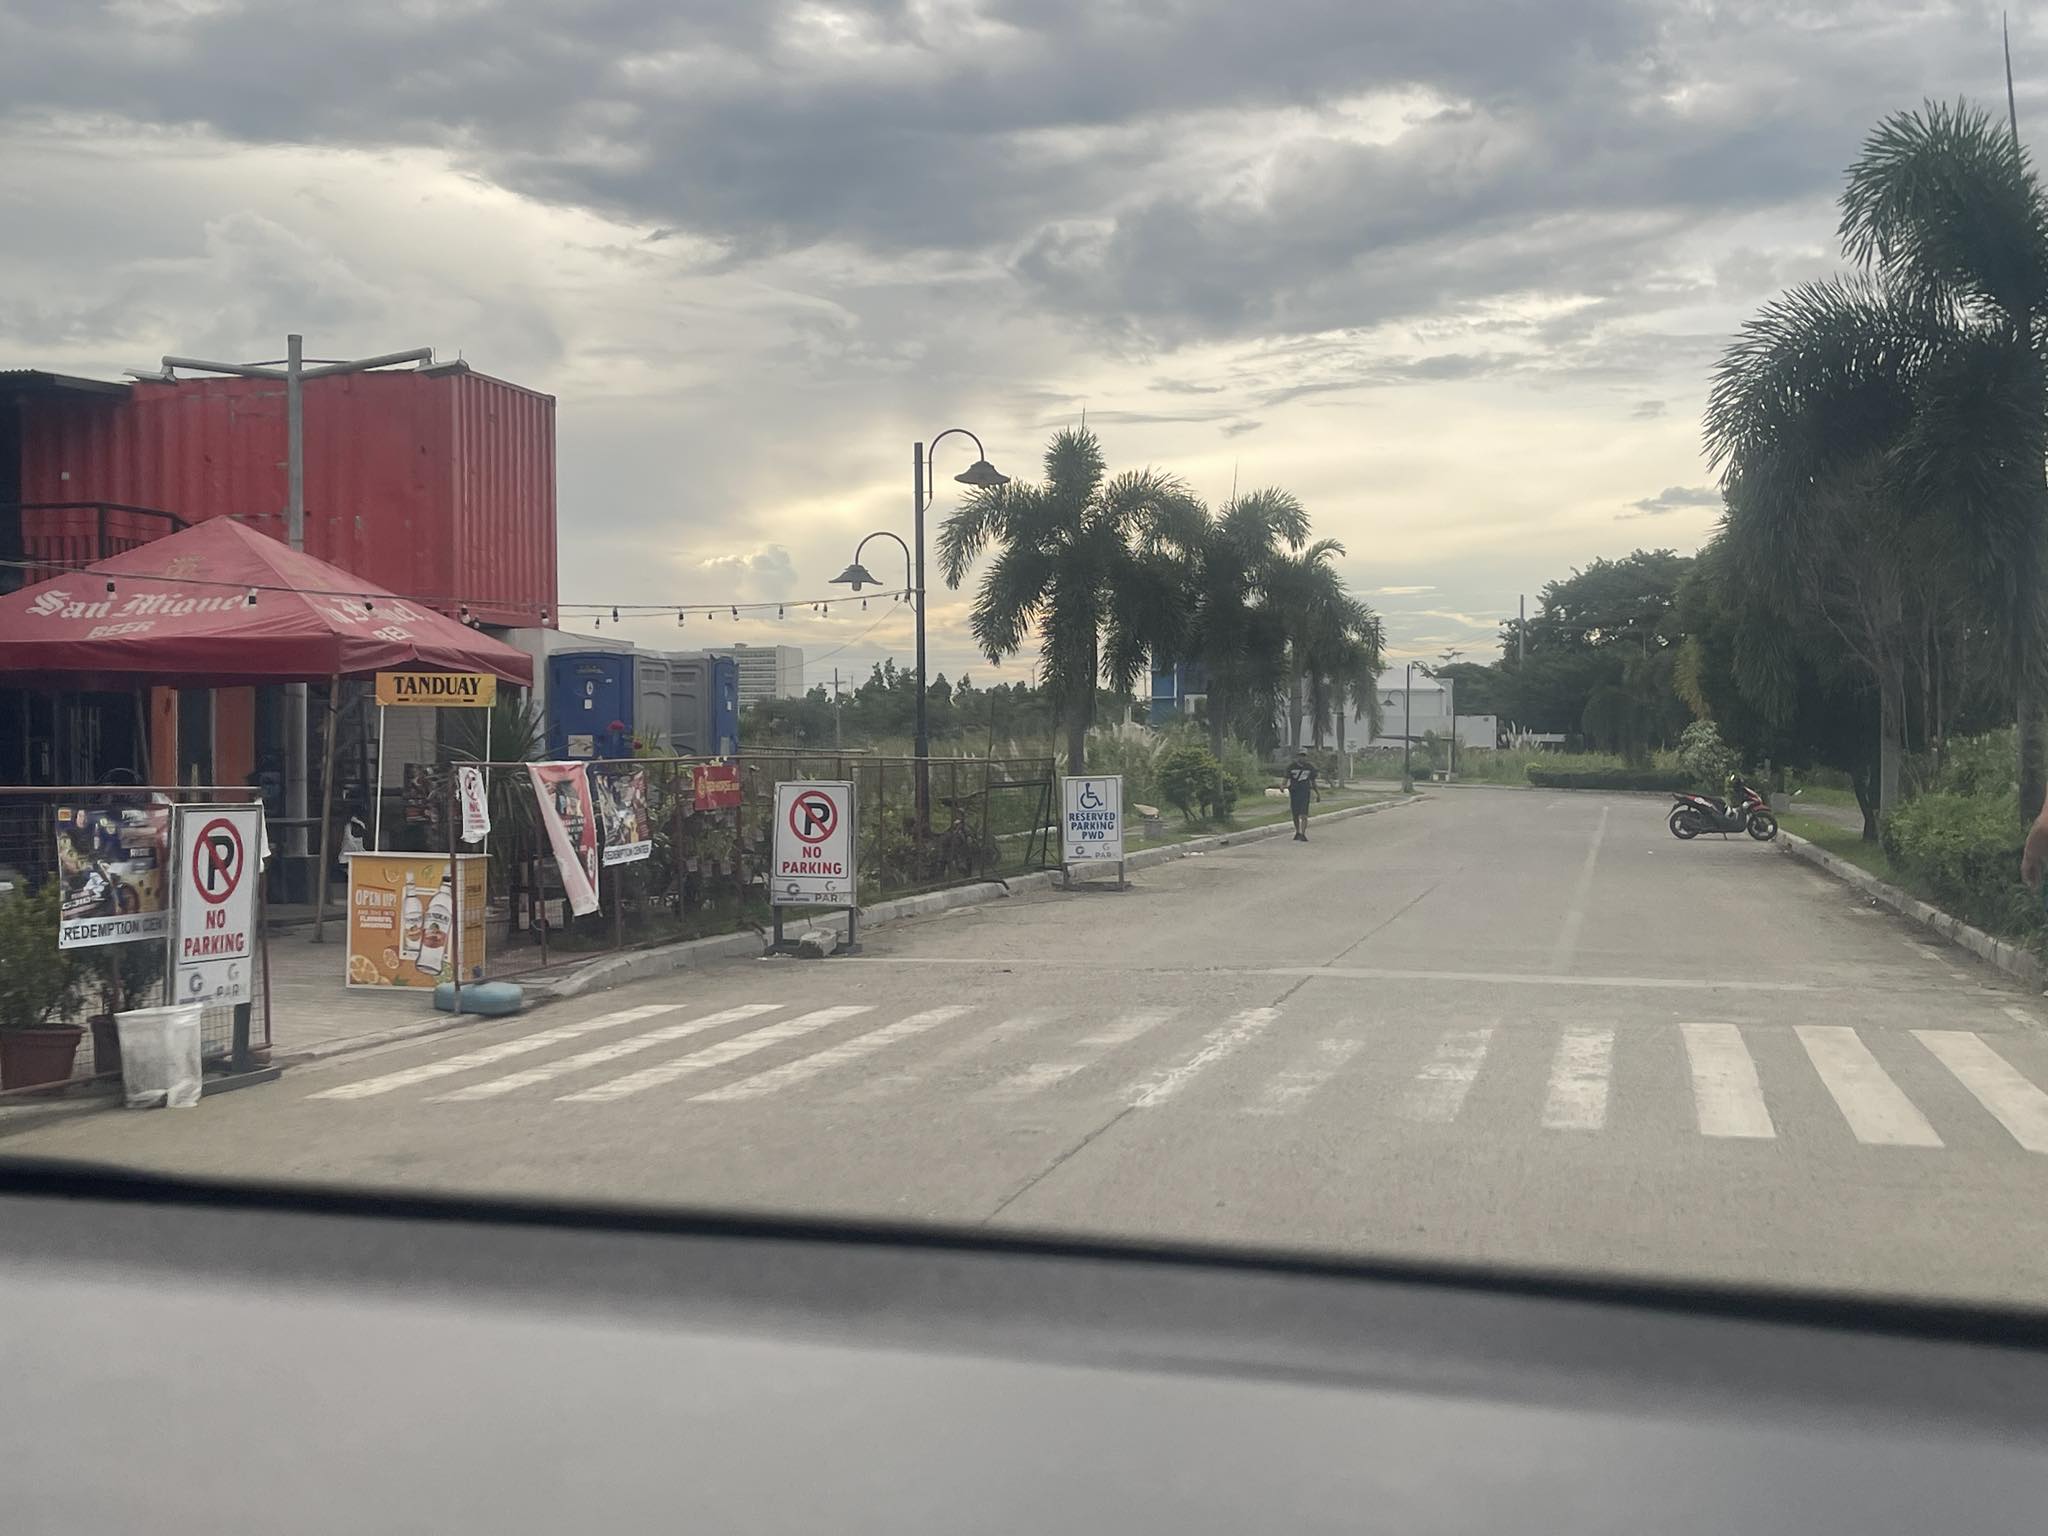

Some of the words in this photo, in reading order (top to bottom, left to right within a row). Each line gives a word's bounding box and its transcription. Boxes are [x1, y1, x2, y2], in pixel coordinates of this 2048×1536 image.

[25, 590, 111, 619] San
[84, 621, 155, 640] BEER
[394, 676, 481, 695] TANDUAY
[1069, 812, 1116, 821] RESERVED
[1071, 821, 1114, 831] PARKING
[1082, 831, 1104, 840] PWD
[802, 846, 822, 858] NO
[782, 861, 842, 875] PARKING
[355, 889, 381, 906] OPEN
[206, 909, 226, 929] NO
[63, 919, 139, 942] REDEMPTION
[184, 933, 244, 957] PARKING
